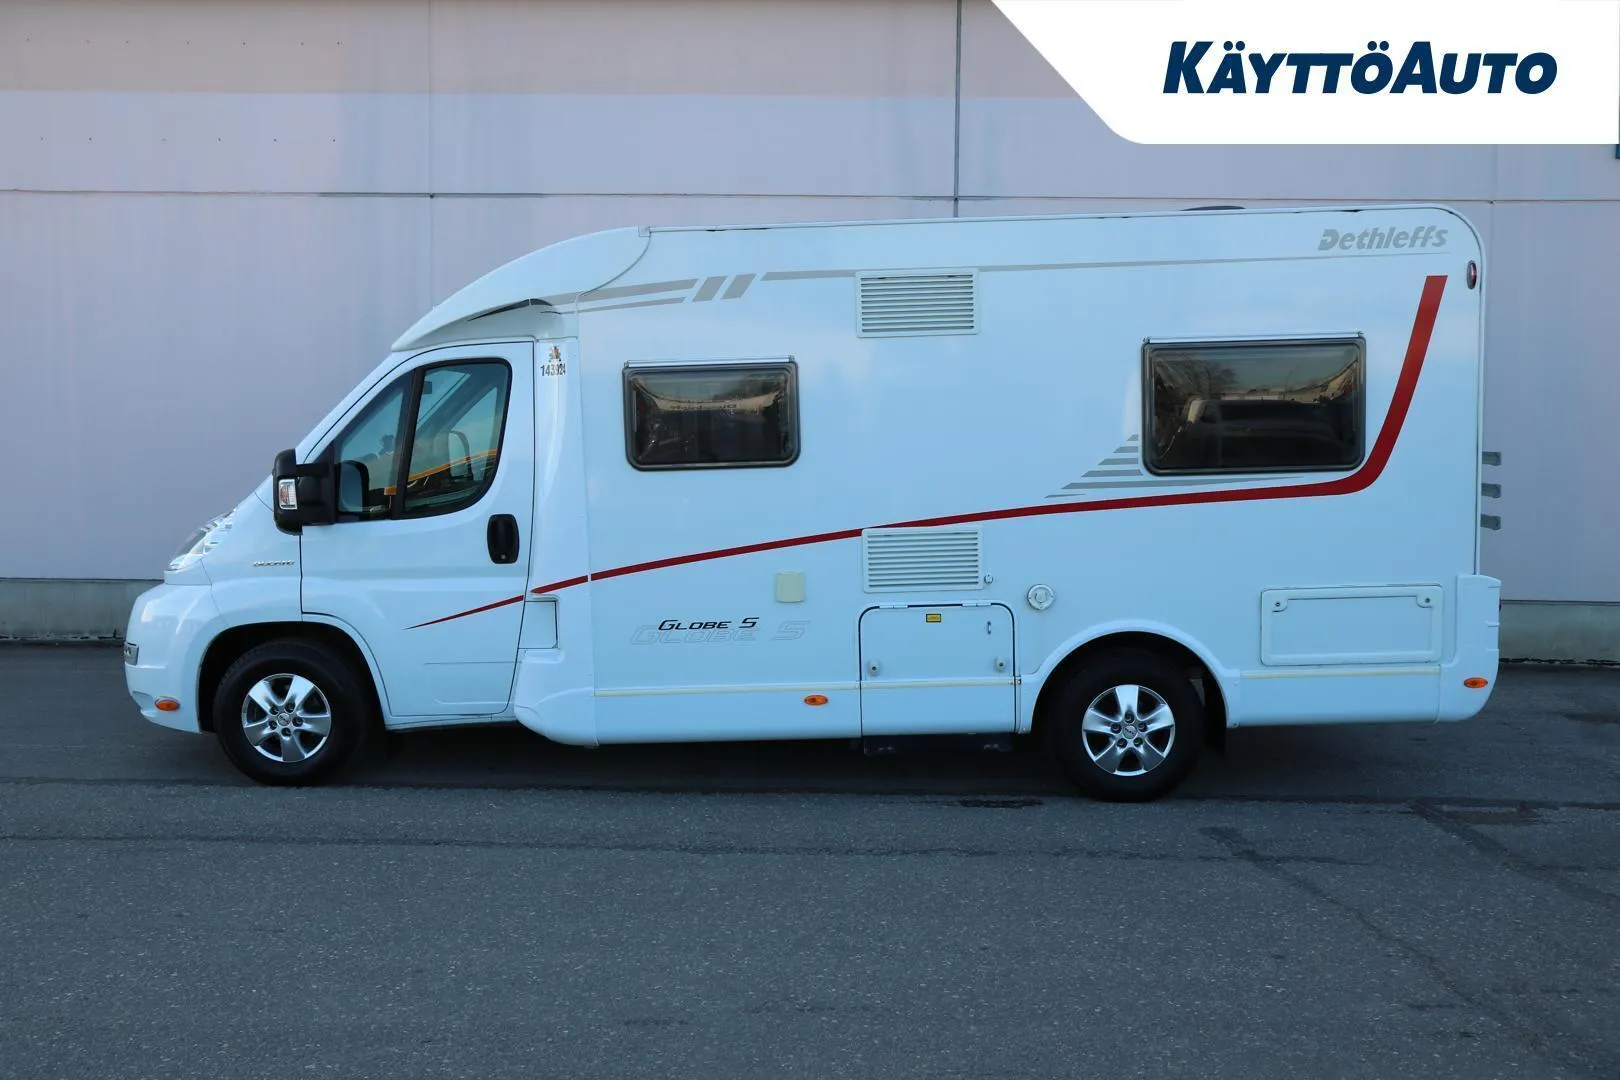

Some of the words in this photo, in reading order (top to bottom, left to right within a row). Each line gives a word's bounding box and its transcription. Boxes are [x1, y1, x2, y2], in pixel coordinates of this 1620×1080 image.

[1318, 225, 1449, 251] Dethleffs
[658, 619, 732, 631] GLOBE
[738, 616, 760, 629] S
